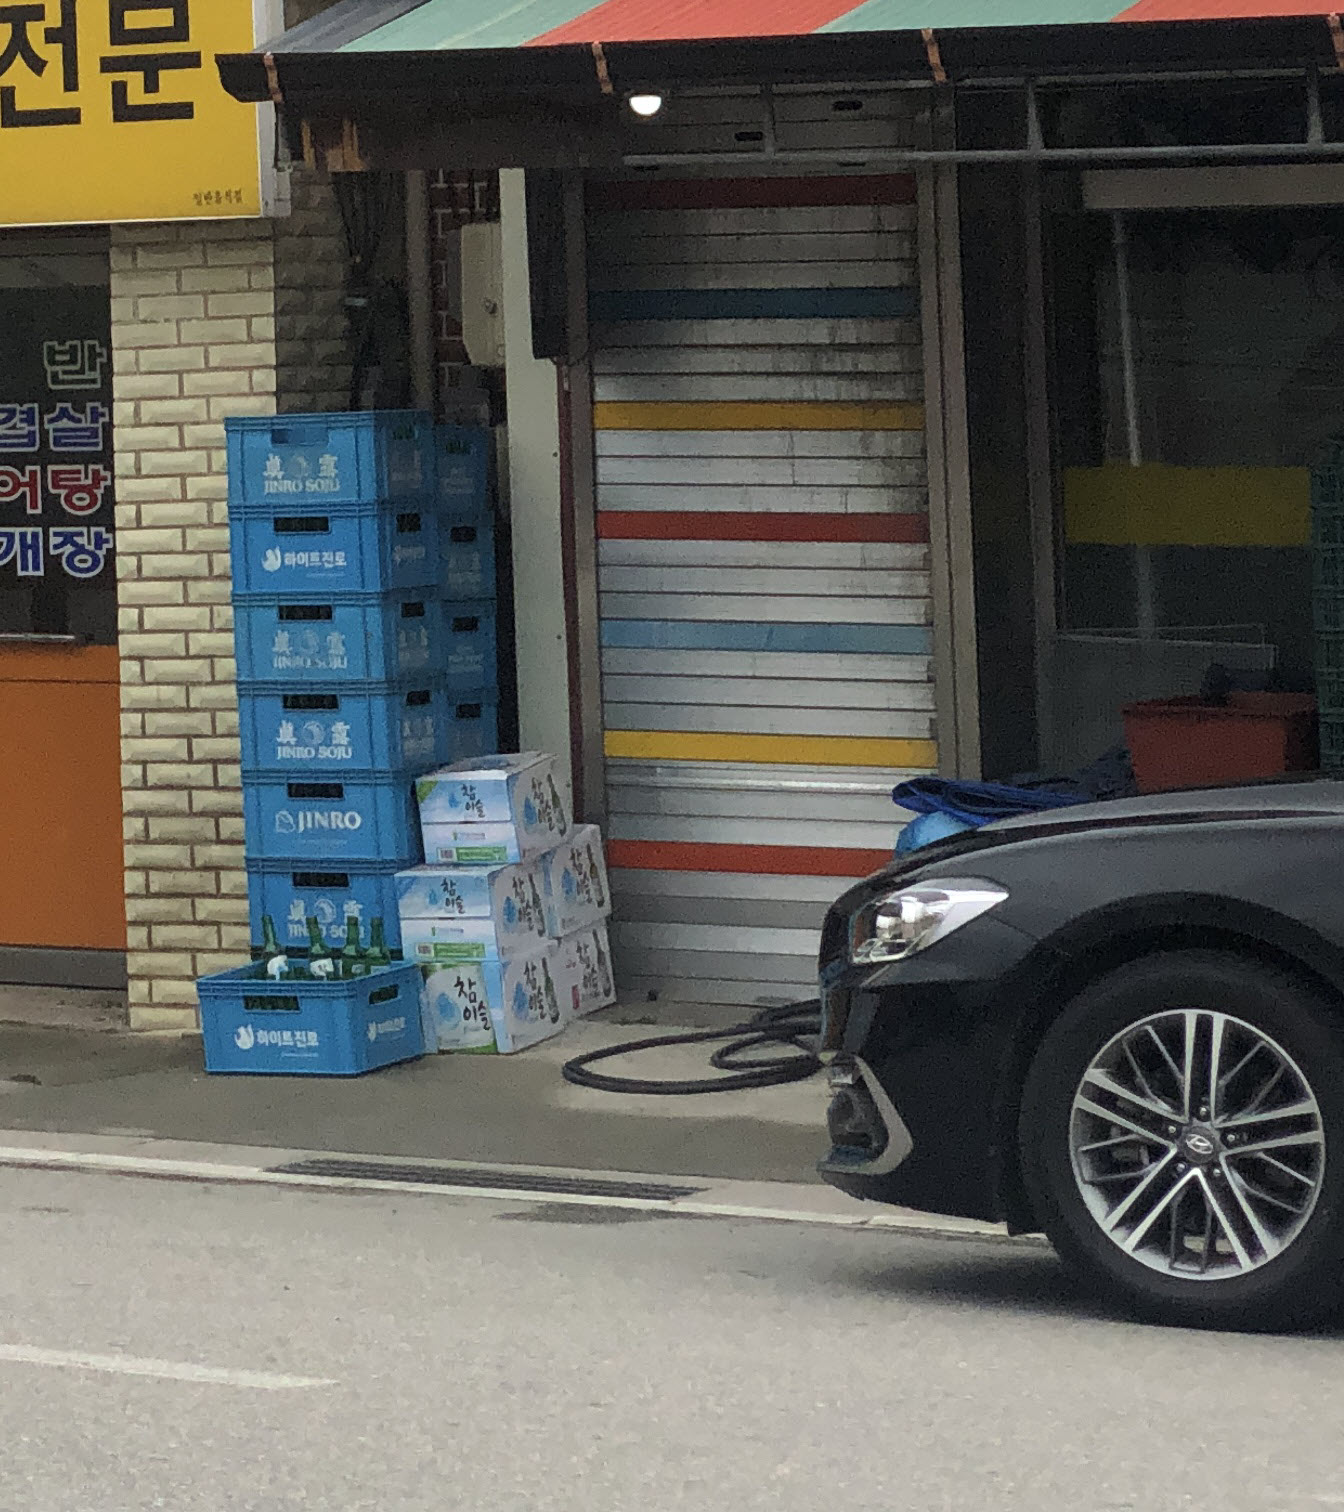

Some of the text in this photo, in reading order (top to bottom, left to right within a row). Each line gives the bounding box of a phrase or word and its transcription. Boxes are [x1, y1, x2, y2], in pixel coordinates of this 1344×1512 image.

[284, 548, 347, 569] 하이트진로
[276, 745, 353, 760] JINRO SOJU
[298, 811, 362, 833] JINRO
[256, 1029, 319, 1048] 하이트진로
